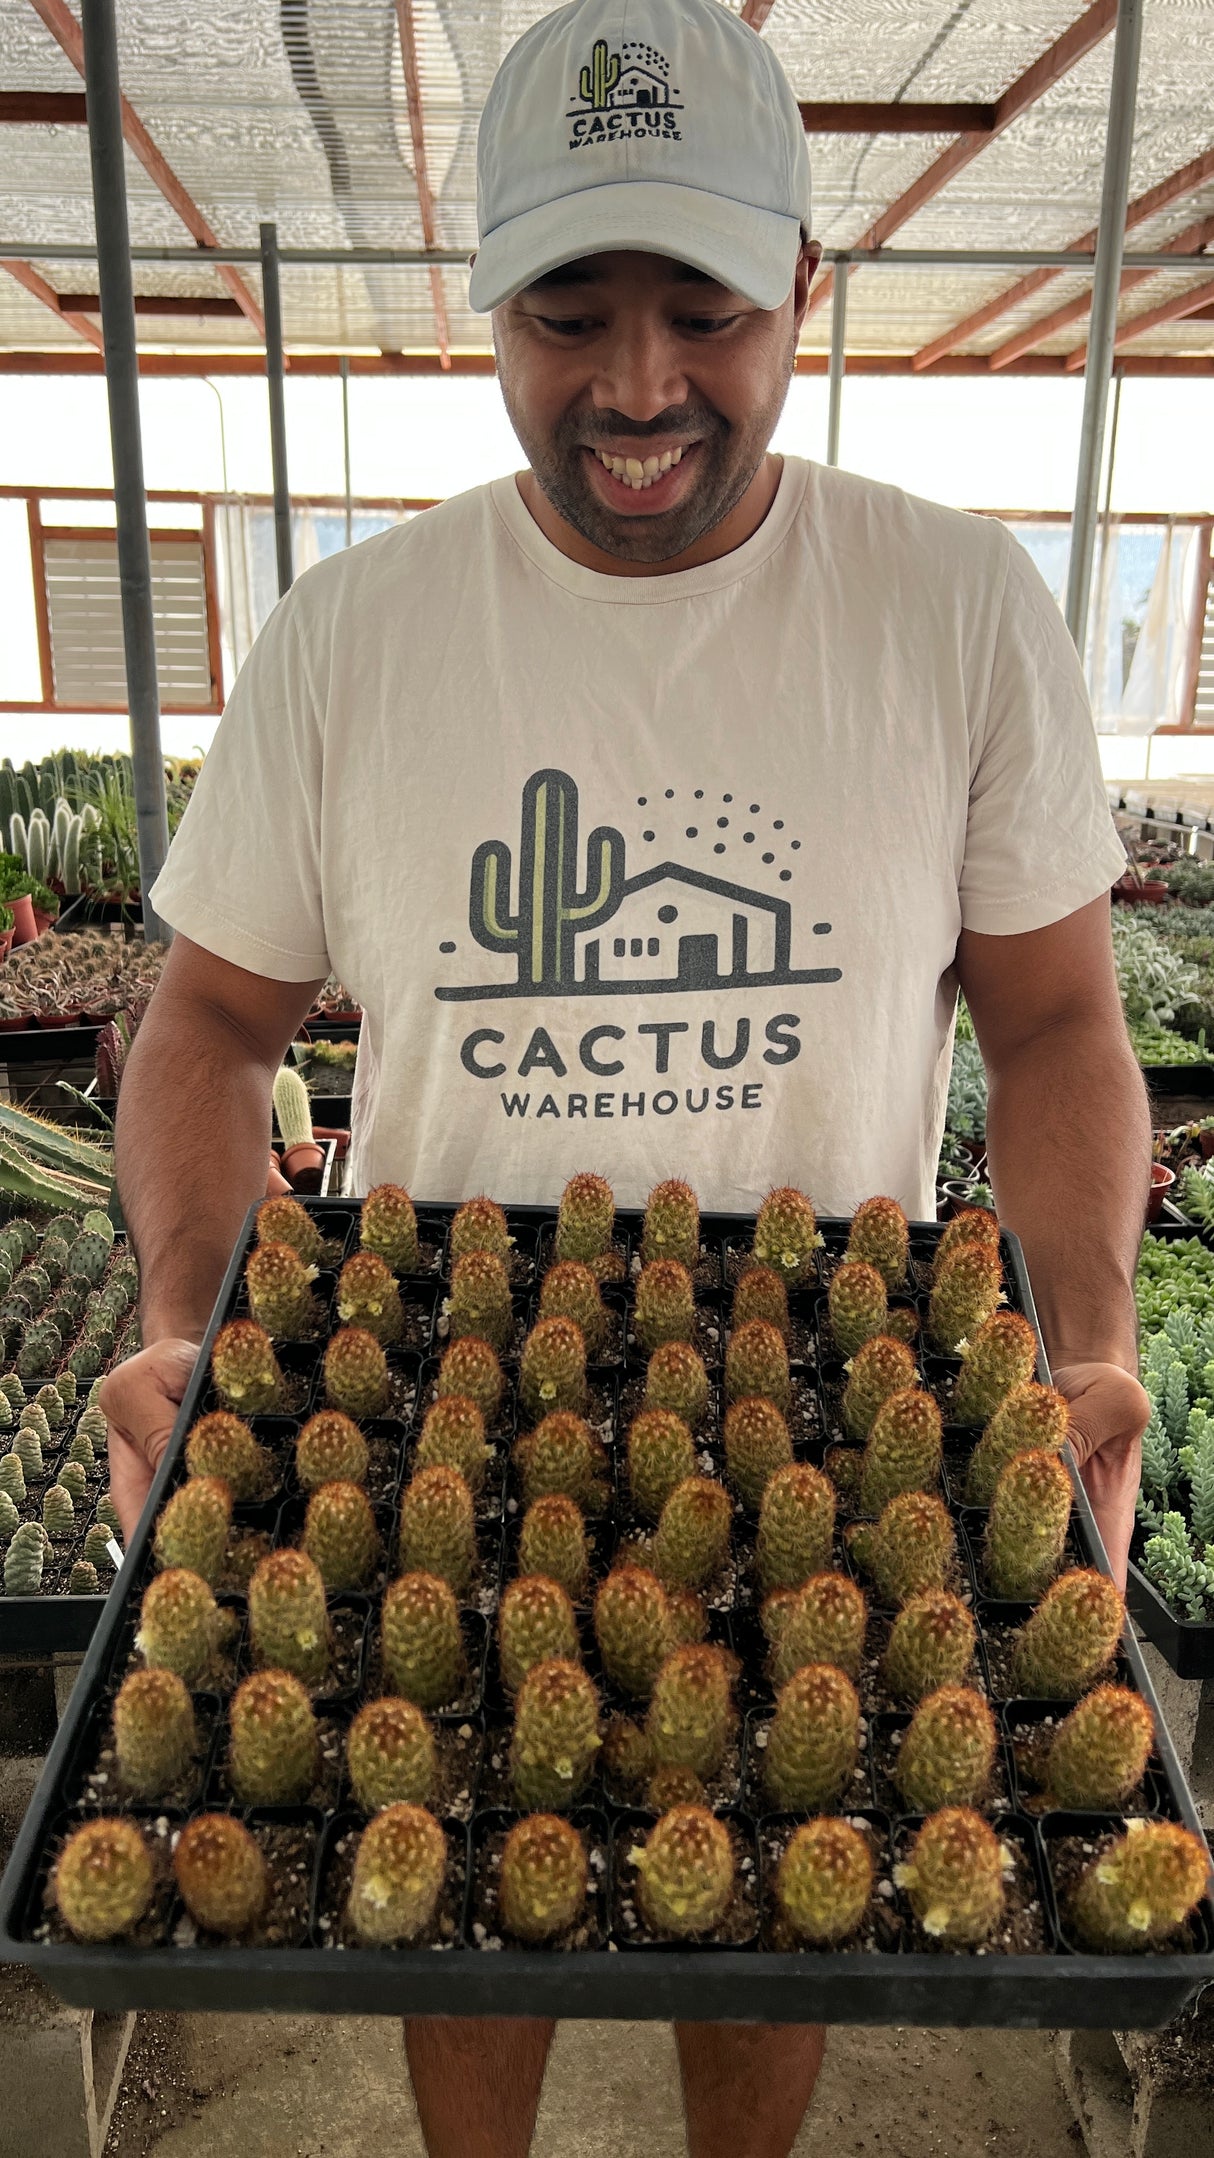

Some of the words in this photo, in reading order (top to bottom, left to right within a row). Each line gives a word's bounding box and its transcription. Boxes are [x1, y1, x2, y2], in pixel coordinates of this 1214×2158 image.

[568, 128, 683, 150] WAREHOUSE
[573, 111, 677, 137] CACTUS
[460, 1013, 802, 1079] CACTUS
[500, 1083, 764, 1119] WAREHOUSE
